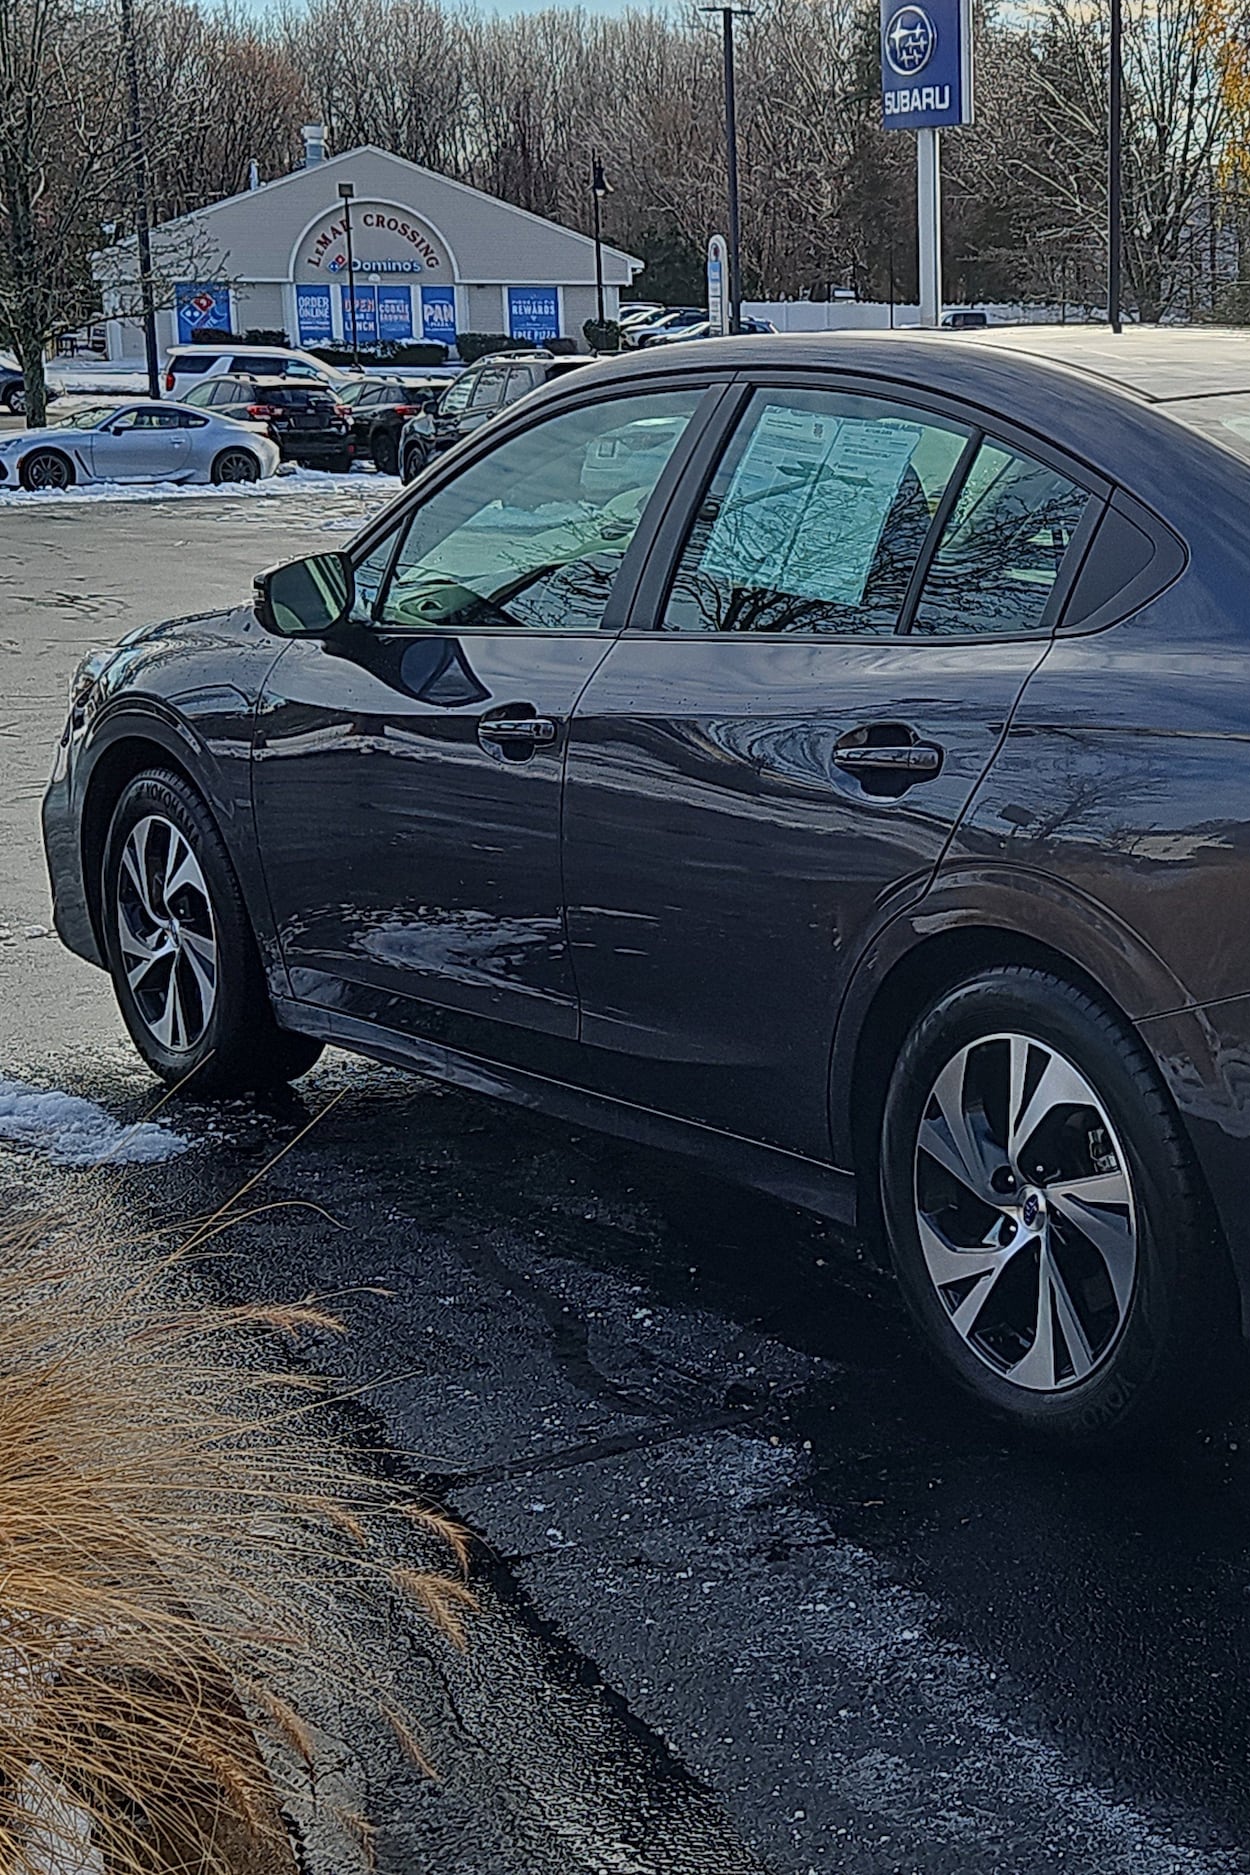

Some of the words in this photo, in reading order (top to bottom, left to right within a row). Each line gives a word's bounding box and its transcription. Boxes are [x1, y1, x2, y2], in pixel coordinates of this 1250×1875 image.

[884, 85, 950, 116] SUBARU
[363, 213, 439, 269] CROSSING
[351, 258, 421, 273] Domino's
[298, 296, 329, 308] ORDER
[512, 304, 555, 315] REWARDS
[299, 307, 330, 319] ONLINE
[423, 303, 454, 323] PAN
